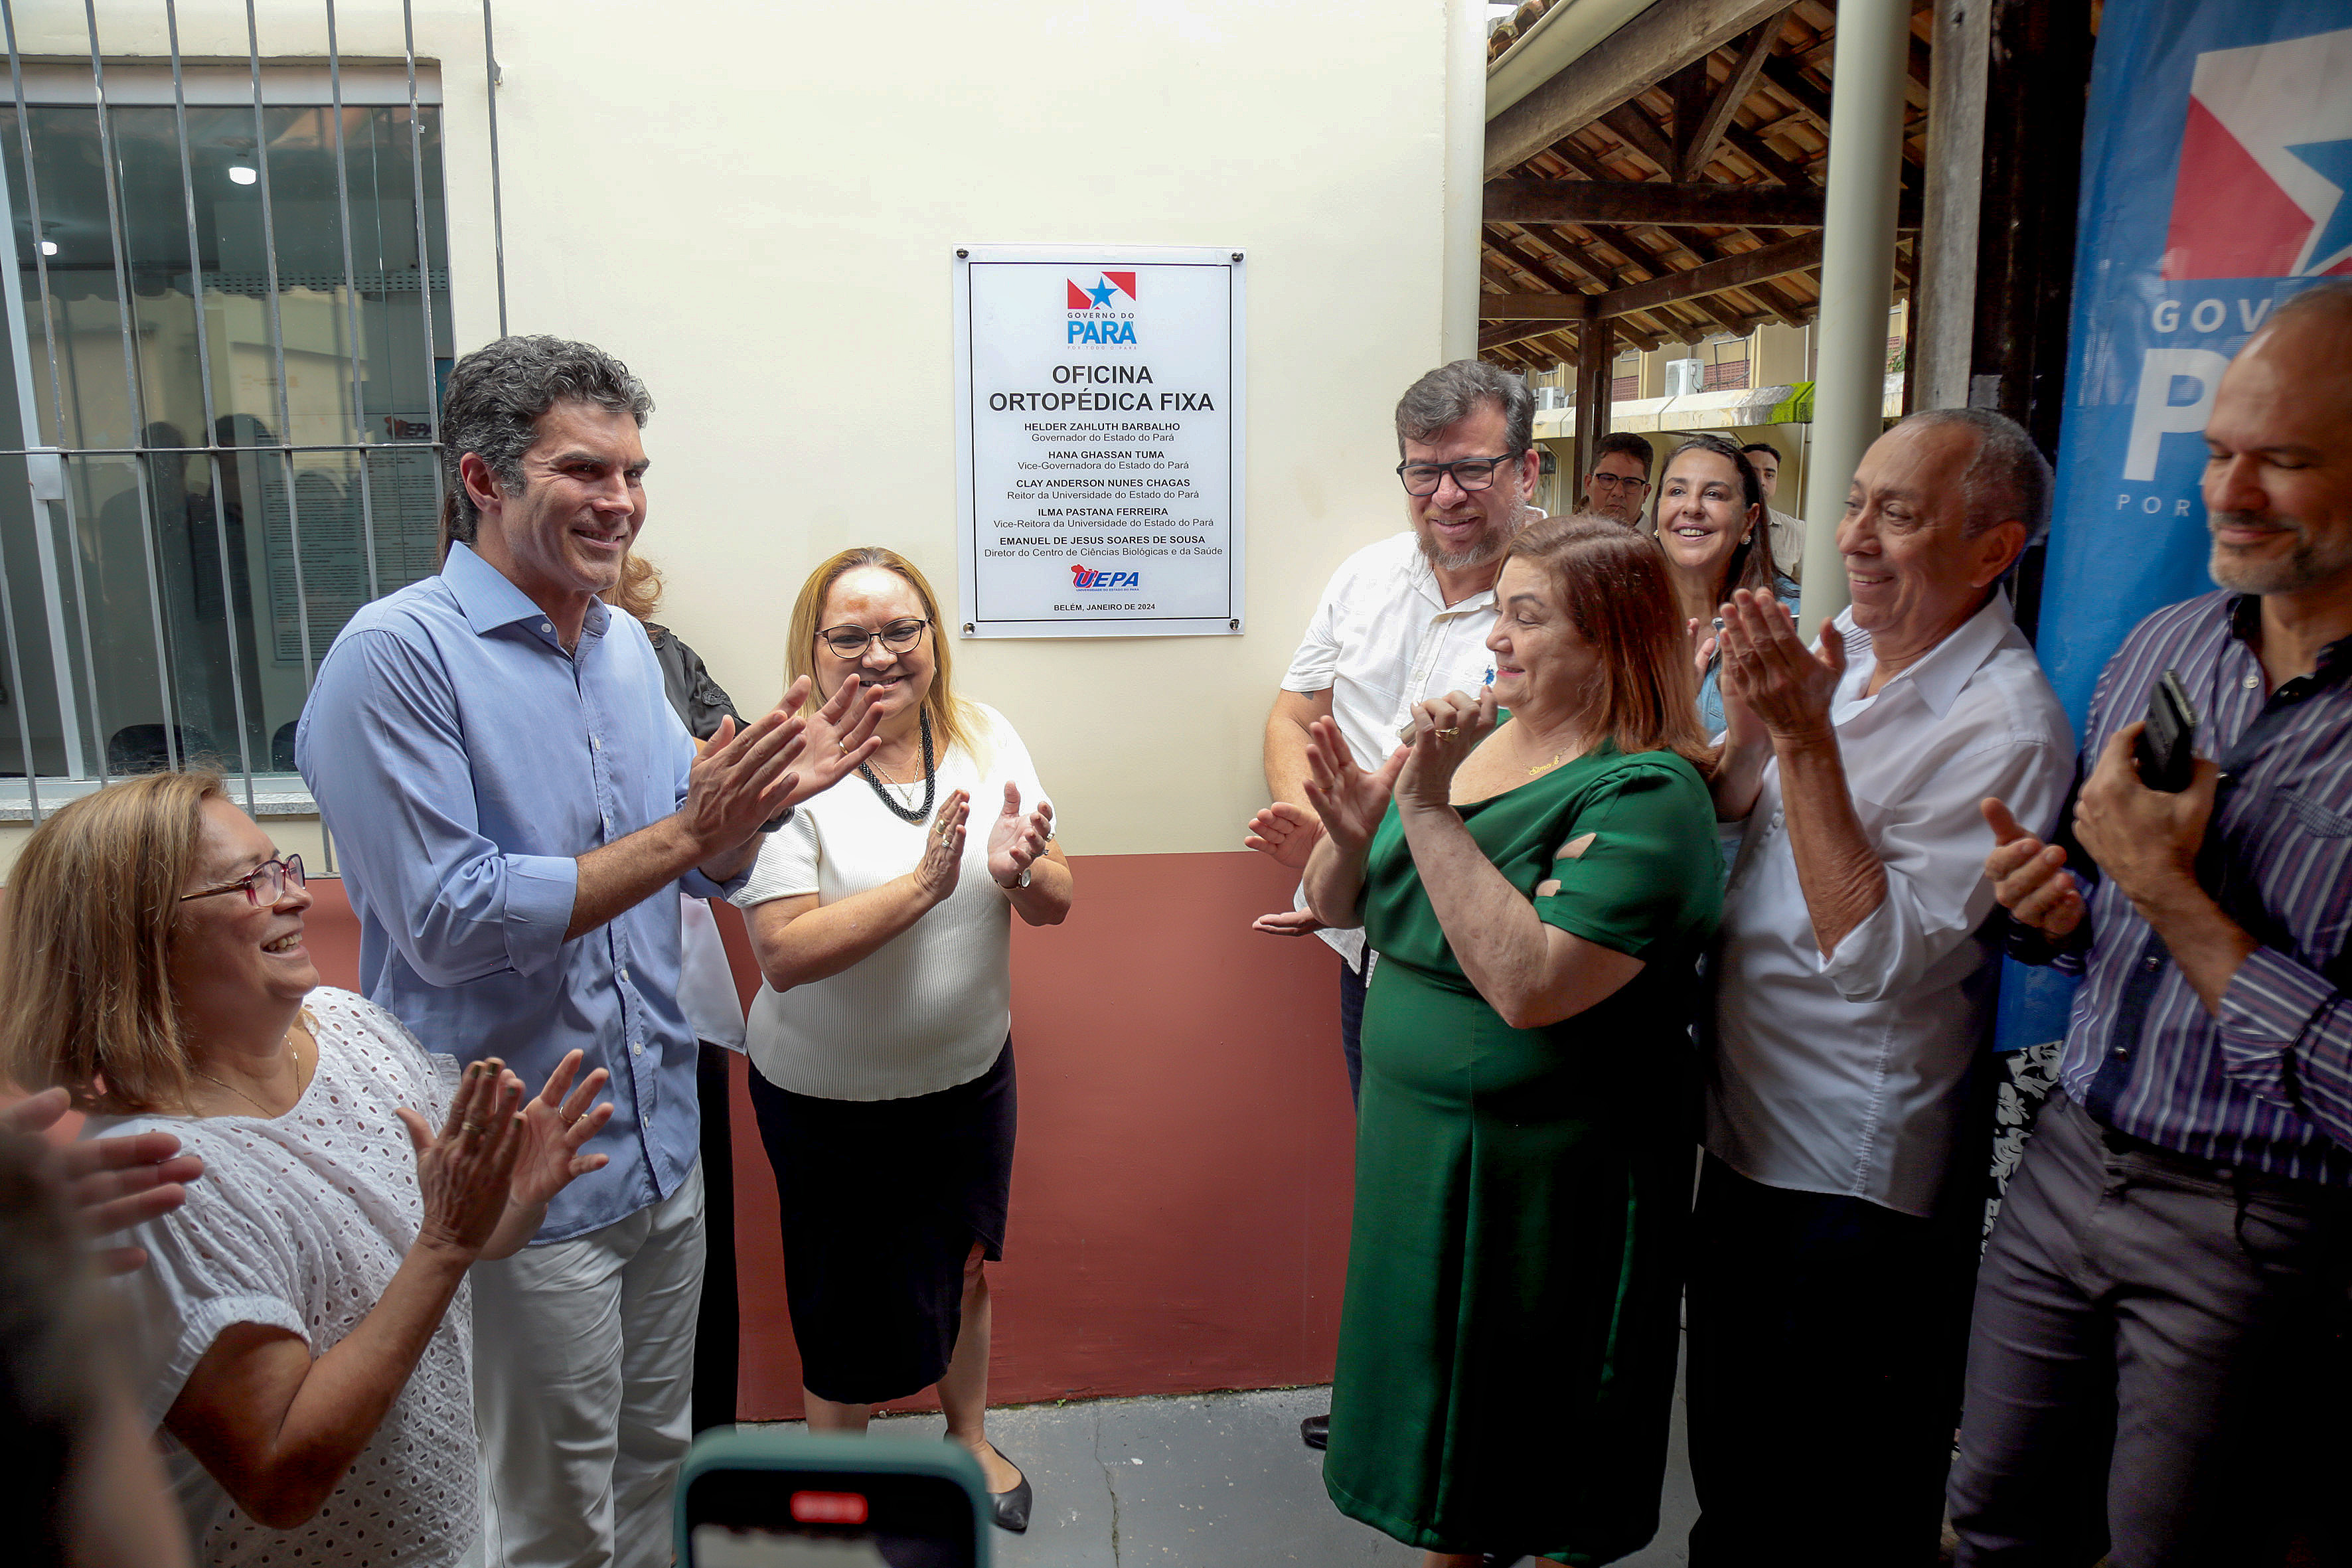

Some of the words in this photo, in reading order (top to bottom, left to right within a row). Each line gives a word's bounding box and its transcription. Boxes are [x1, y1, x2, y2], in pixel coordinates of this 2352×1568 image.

[2152, 299, 2273, 333] GOV
[1052, 365, 1153, 384] OFICINA
[989, 388, 1153, 411] ORTOPÉDICA
[1160, 393, 1215, 411] FIXA
[1024, 423, 1067, 431] HELDER
[1069, 423, 1119, 431] ZAHLUTH
[1122, 423, 1180, 431] BARBALHO
[1032, 433, 1087, 442] Governador
[1089, 433, 1101, 442] do
[1104, 433, 1136, 441] Estado
[1138, 433, 1150, 441] do
[1152, 433, 1174, 441] Pará
[1048, 451, 1078, 459] HANA
[1081, 451, 1132, 459] GHASSAN
[1017, 461, 1101, 470] Vice-Governadora
[1105, 461, 1116, 469] do
[1119, 461, 1150, 469] Estado
[1153, 461, 1165, 469] do
[1168, 461, 1189, 469] Pará
[1016, 479, 1043, 488] CLAY
[1046, 479, 1105, 488] ANDERSON
[1108, 479, 1143, 487] NUNES
[1146, 479, 1190, 487] CHAGAS
[1007, 491, 1035, 500] Reitor
[1038, 491, 1049, 500] da
[1052, 491, 1112, 499] Universidade
[1115, 491, 1127, 499] do
[1129, 491, 1161, 499] Estado
[1164, 490, 1175, 499] do
[1178, 490, 1200, 499] Pará
[2116, 494, 2191, 516] POR
[1038, 508, 1063, 516] ILMA
[1065, 508, 1114, 516] PASTANA
[1116, 507, 1168, 516] FERREIRA
[993, 520, 1050, 528] Vice-Reitora
[1053, 519, 1064, 528] da
[1067, 519, 1127, 528] Universidade
[1130, 518, 1141, 527] do
[1144, 518, 1176, 527] Estado
[1178, 518, 1190, 526] do
[1192, 518, 1214, 526] Pará
[1000, 537, 1051, 546] EMANUEL
[1054, 536, 1067, 545] DE
[1070, 536, 1104, 545] JESUS
[1152, 536, 1166, 544] DE
[984, 549, 1016, 558] Diretor
[1018, 548, 1030, 557] do
[1032, 548, 1063, 557] Centro
[1066, 548, 1077, 557] de
[1122, 548, 1169, 558] Biológicas
[1180, 547, 1190, 556] da
[1075, 572, 1139, 588] UEPA
